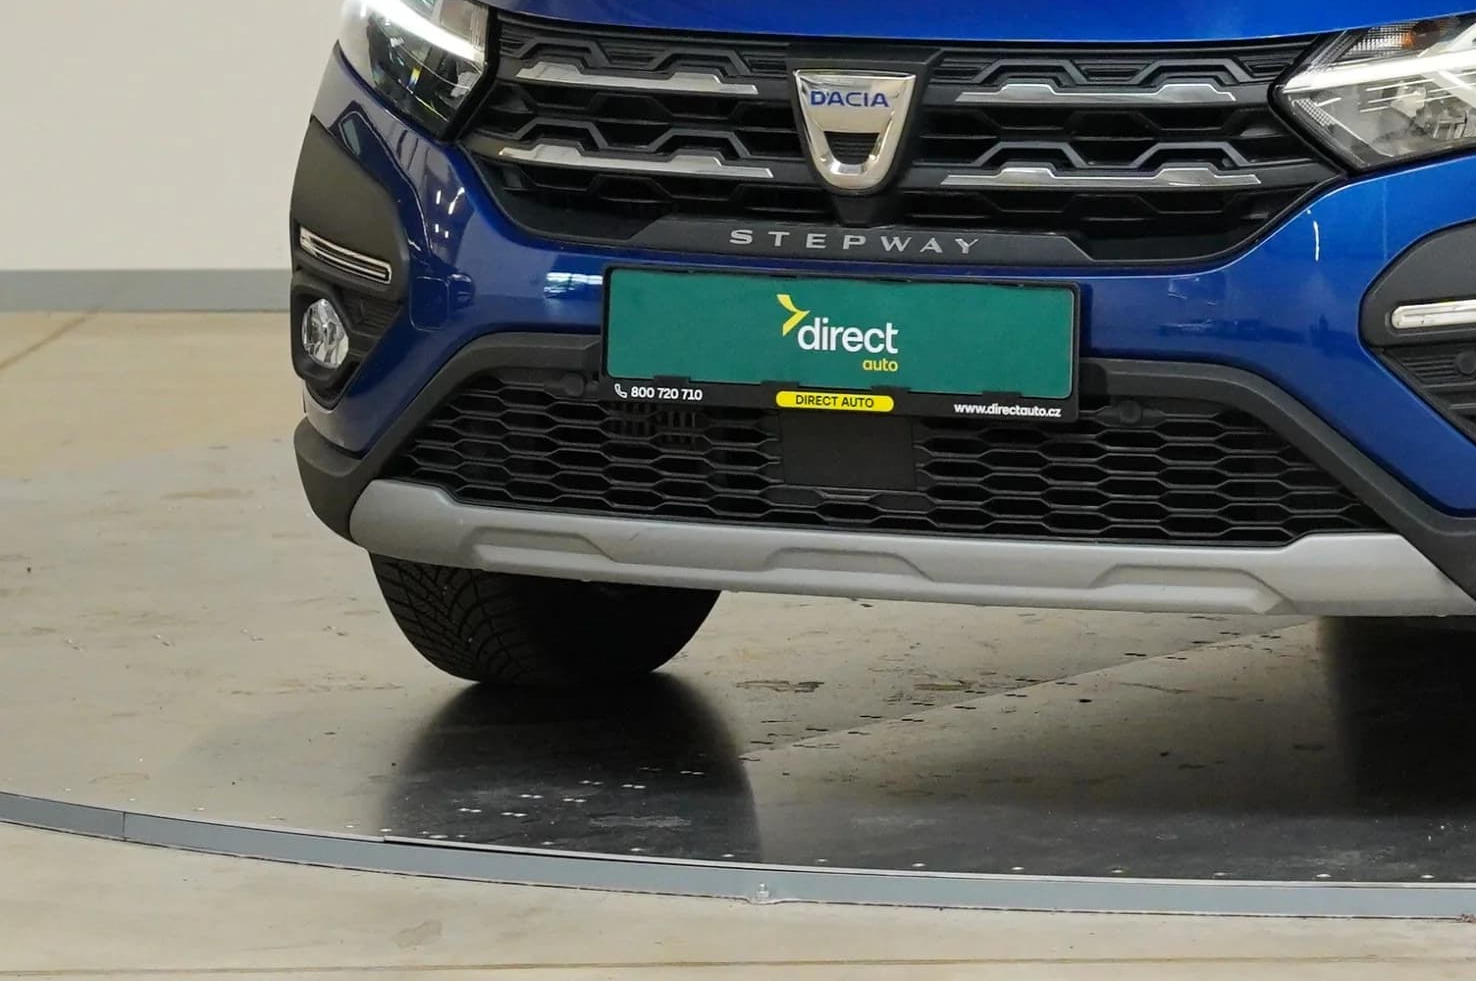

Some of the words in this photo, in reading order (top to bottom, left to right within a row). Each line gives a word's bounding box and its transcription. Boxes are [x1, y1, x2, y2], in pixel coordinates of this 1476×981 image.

[810, 90, 889, 108] DACIA
[729, 229, 979, 254] STEPWAY
[797, 317, 899, 354] direct
[862, 358, 898, 372] auto
[630, 386, 655, 398] 800
[657, 387, 679, 399] 720
[681, 389, 703, 401] 710
[795, 395, 838, 407] DIRECT
[841, 396, 874, 408] AUTO
[954, 403, 1061, 417] www.directauto.cz
